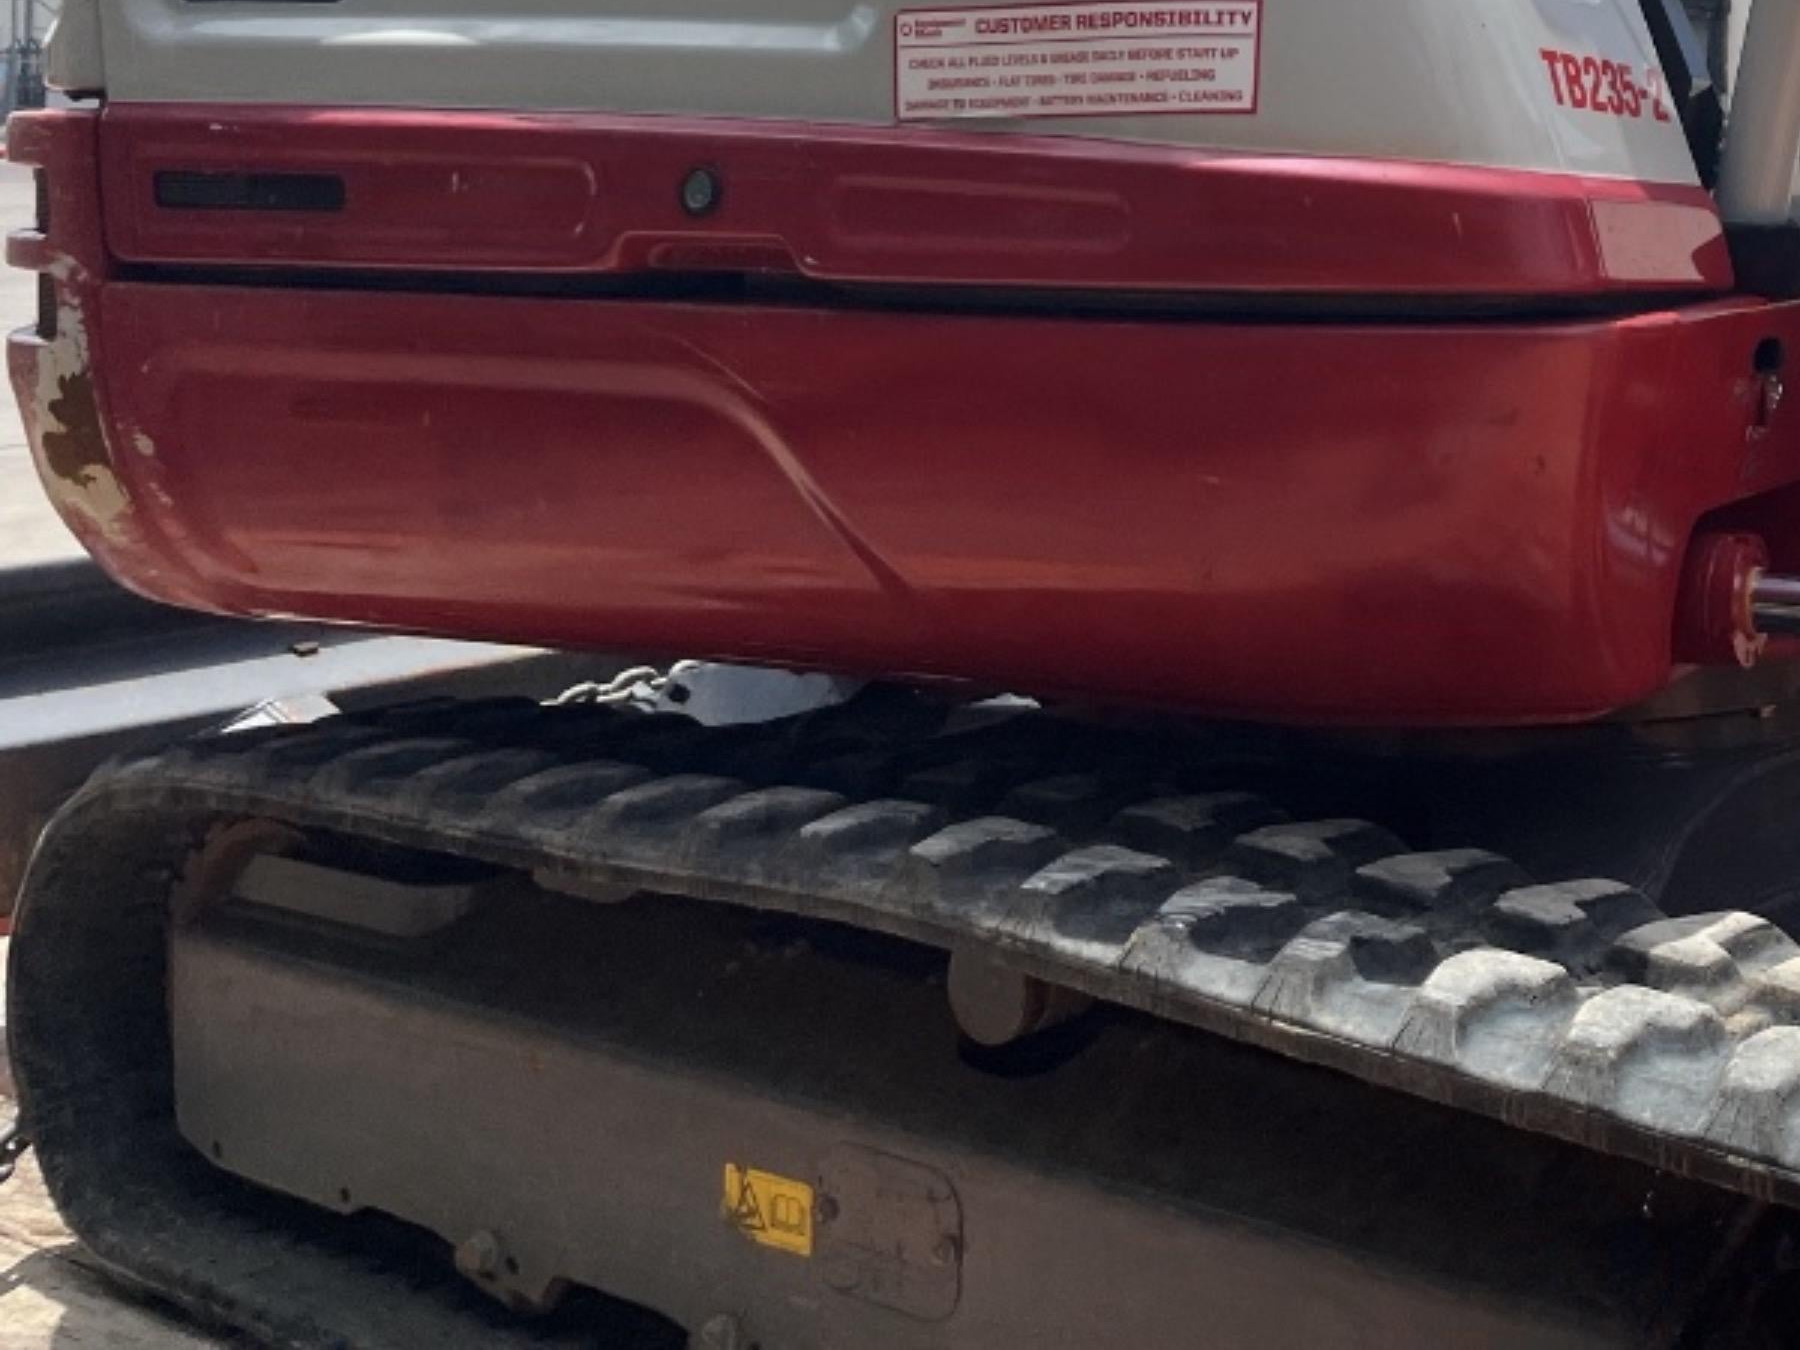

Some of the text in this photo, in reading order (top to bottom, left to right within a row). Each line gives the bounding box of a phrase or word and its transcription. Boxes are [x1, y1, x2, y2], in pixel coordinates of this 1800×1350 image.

[974, 15, 1072, 35] CUSTOMER
[1076, 10, 1252, 31] RESPONSIBILITY
[1539, 47, 1672, 123] TB235-2
